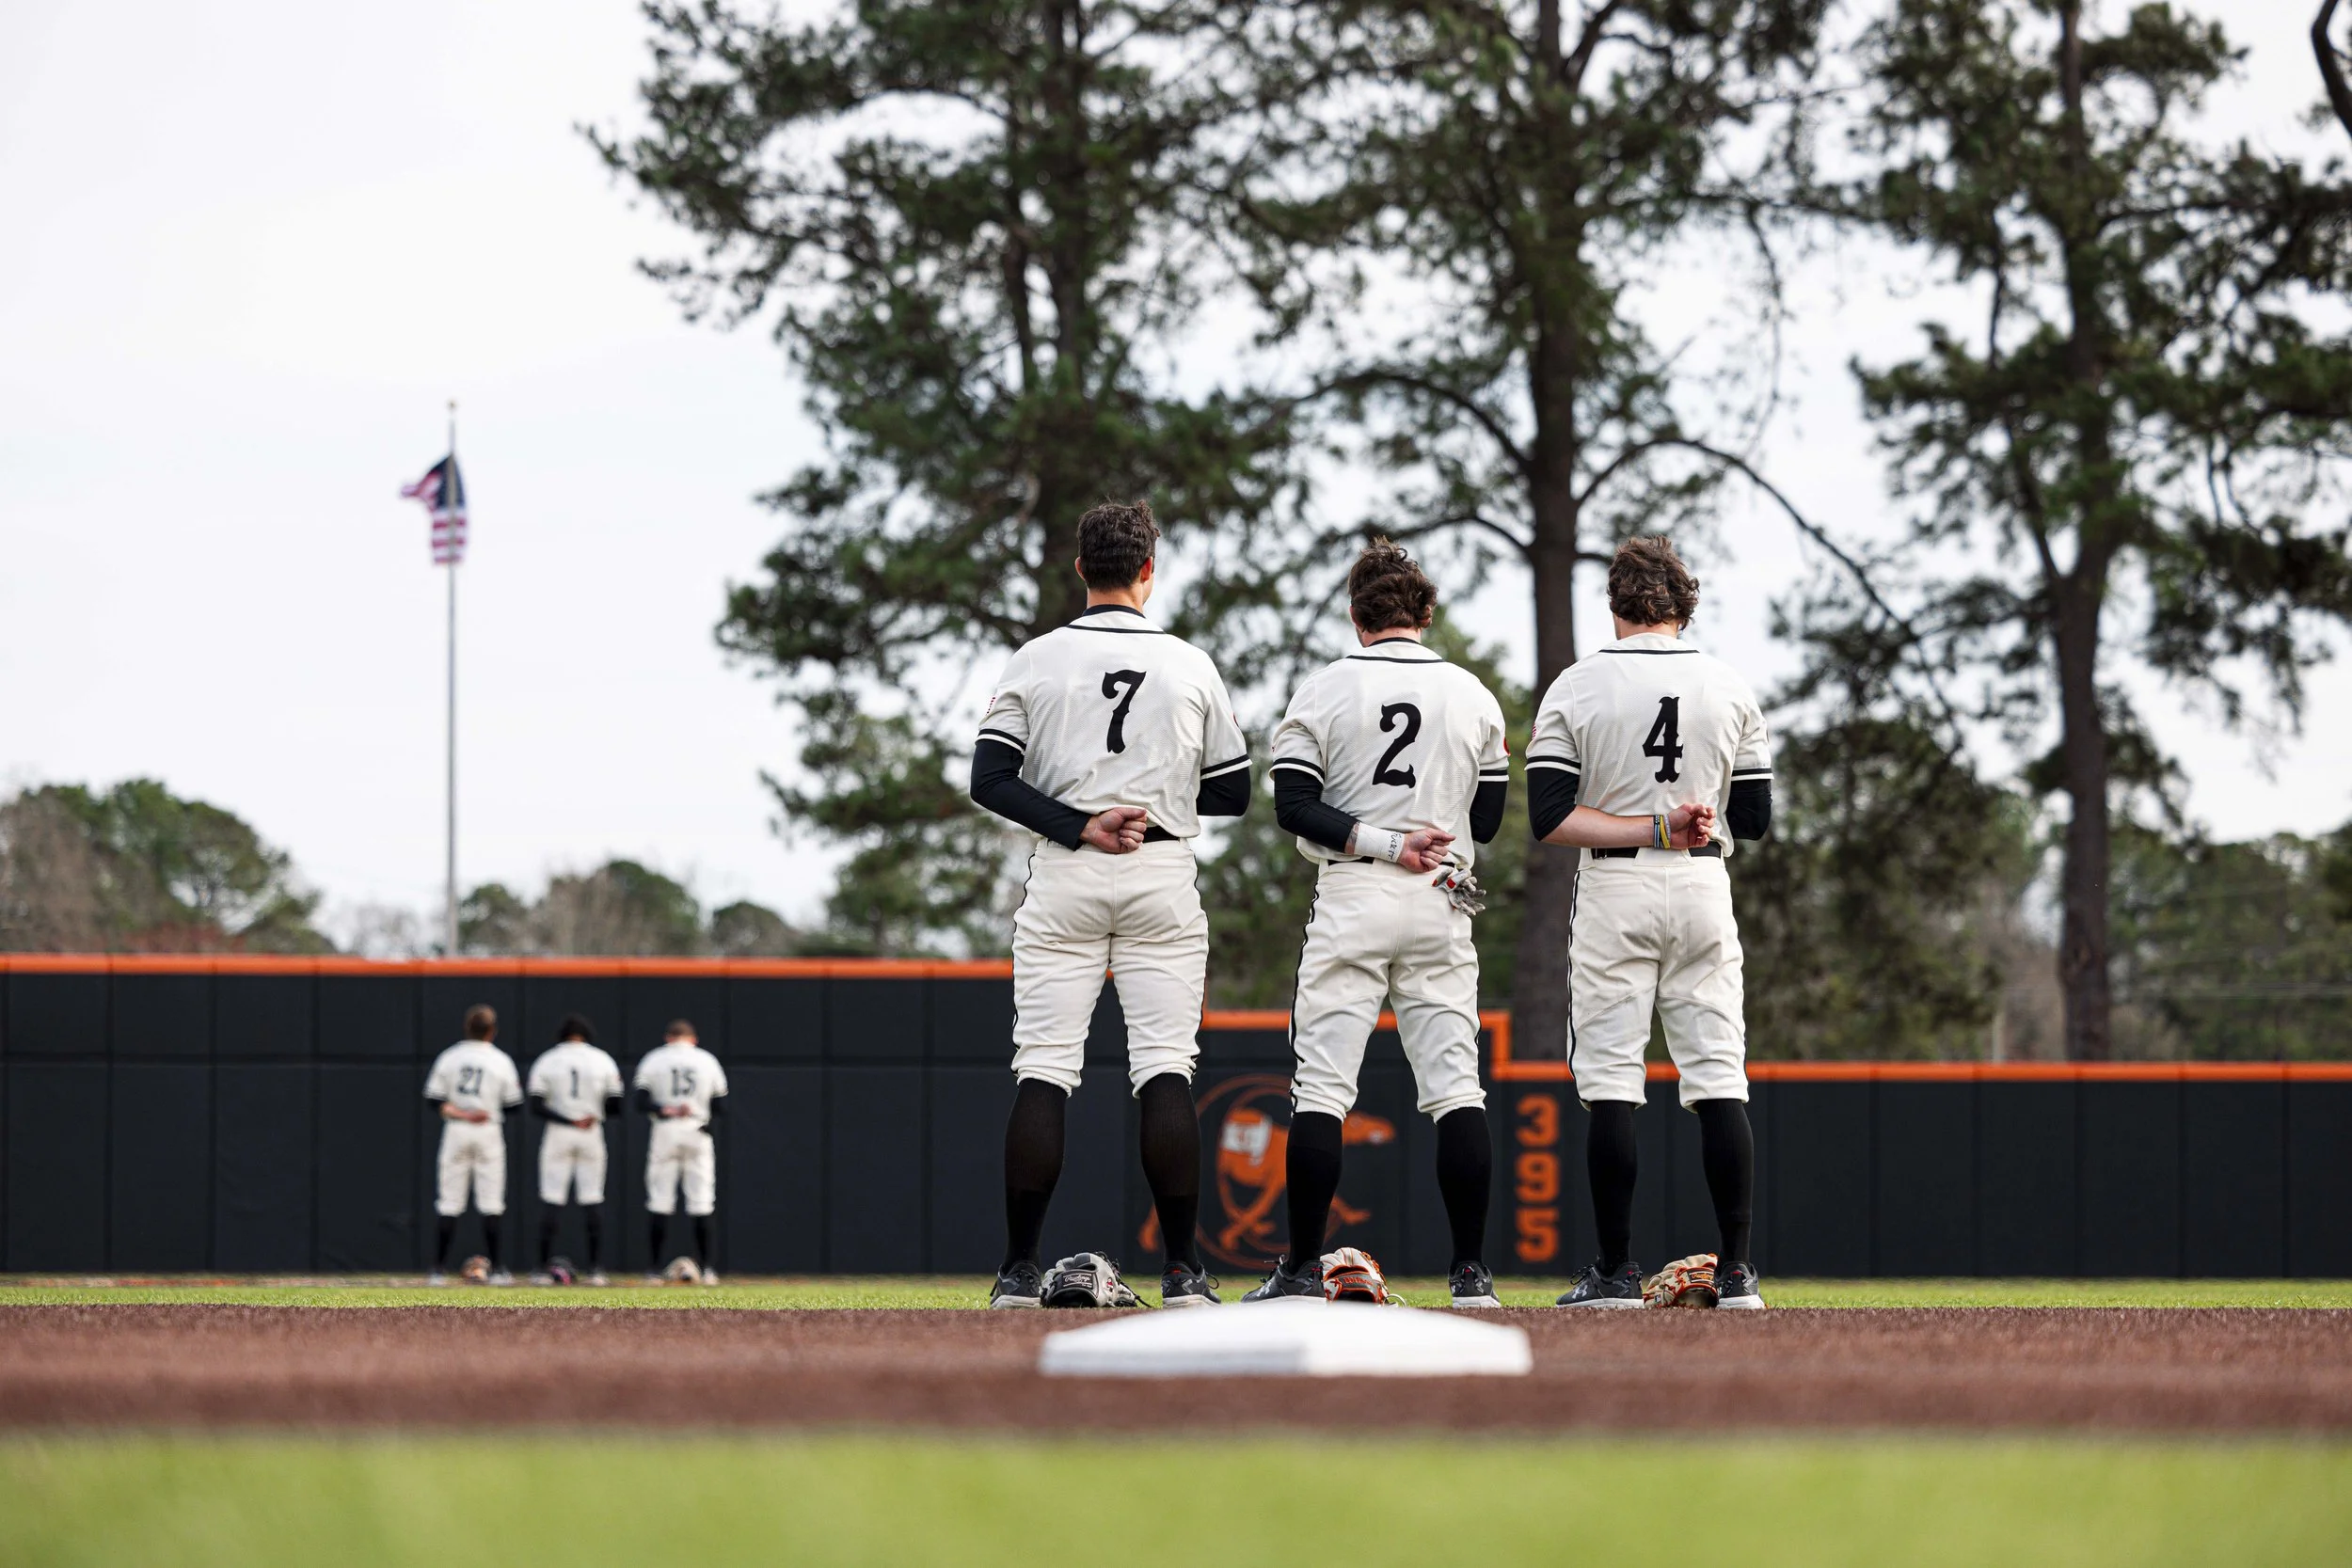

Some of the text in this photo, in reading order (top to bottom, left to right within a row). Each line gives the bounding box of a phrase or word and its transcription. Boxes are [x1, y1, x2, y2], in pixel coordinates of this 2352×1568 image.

[1101, 669, 1147, 754] 7
[1642, 696, 1684, 784] 4
[1371, 702, 1422, 789] 2
[456, 1065, 484, 1096] 21
[569, 1067, 580, 1099] 1
[671, 1067, 697, 1097] 15
